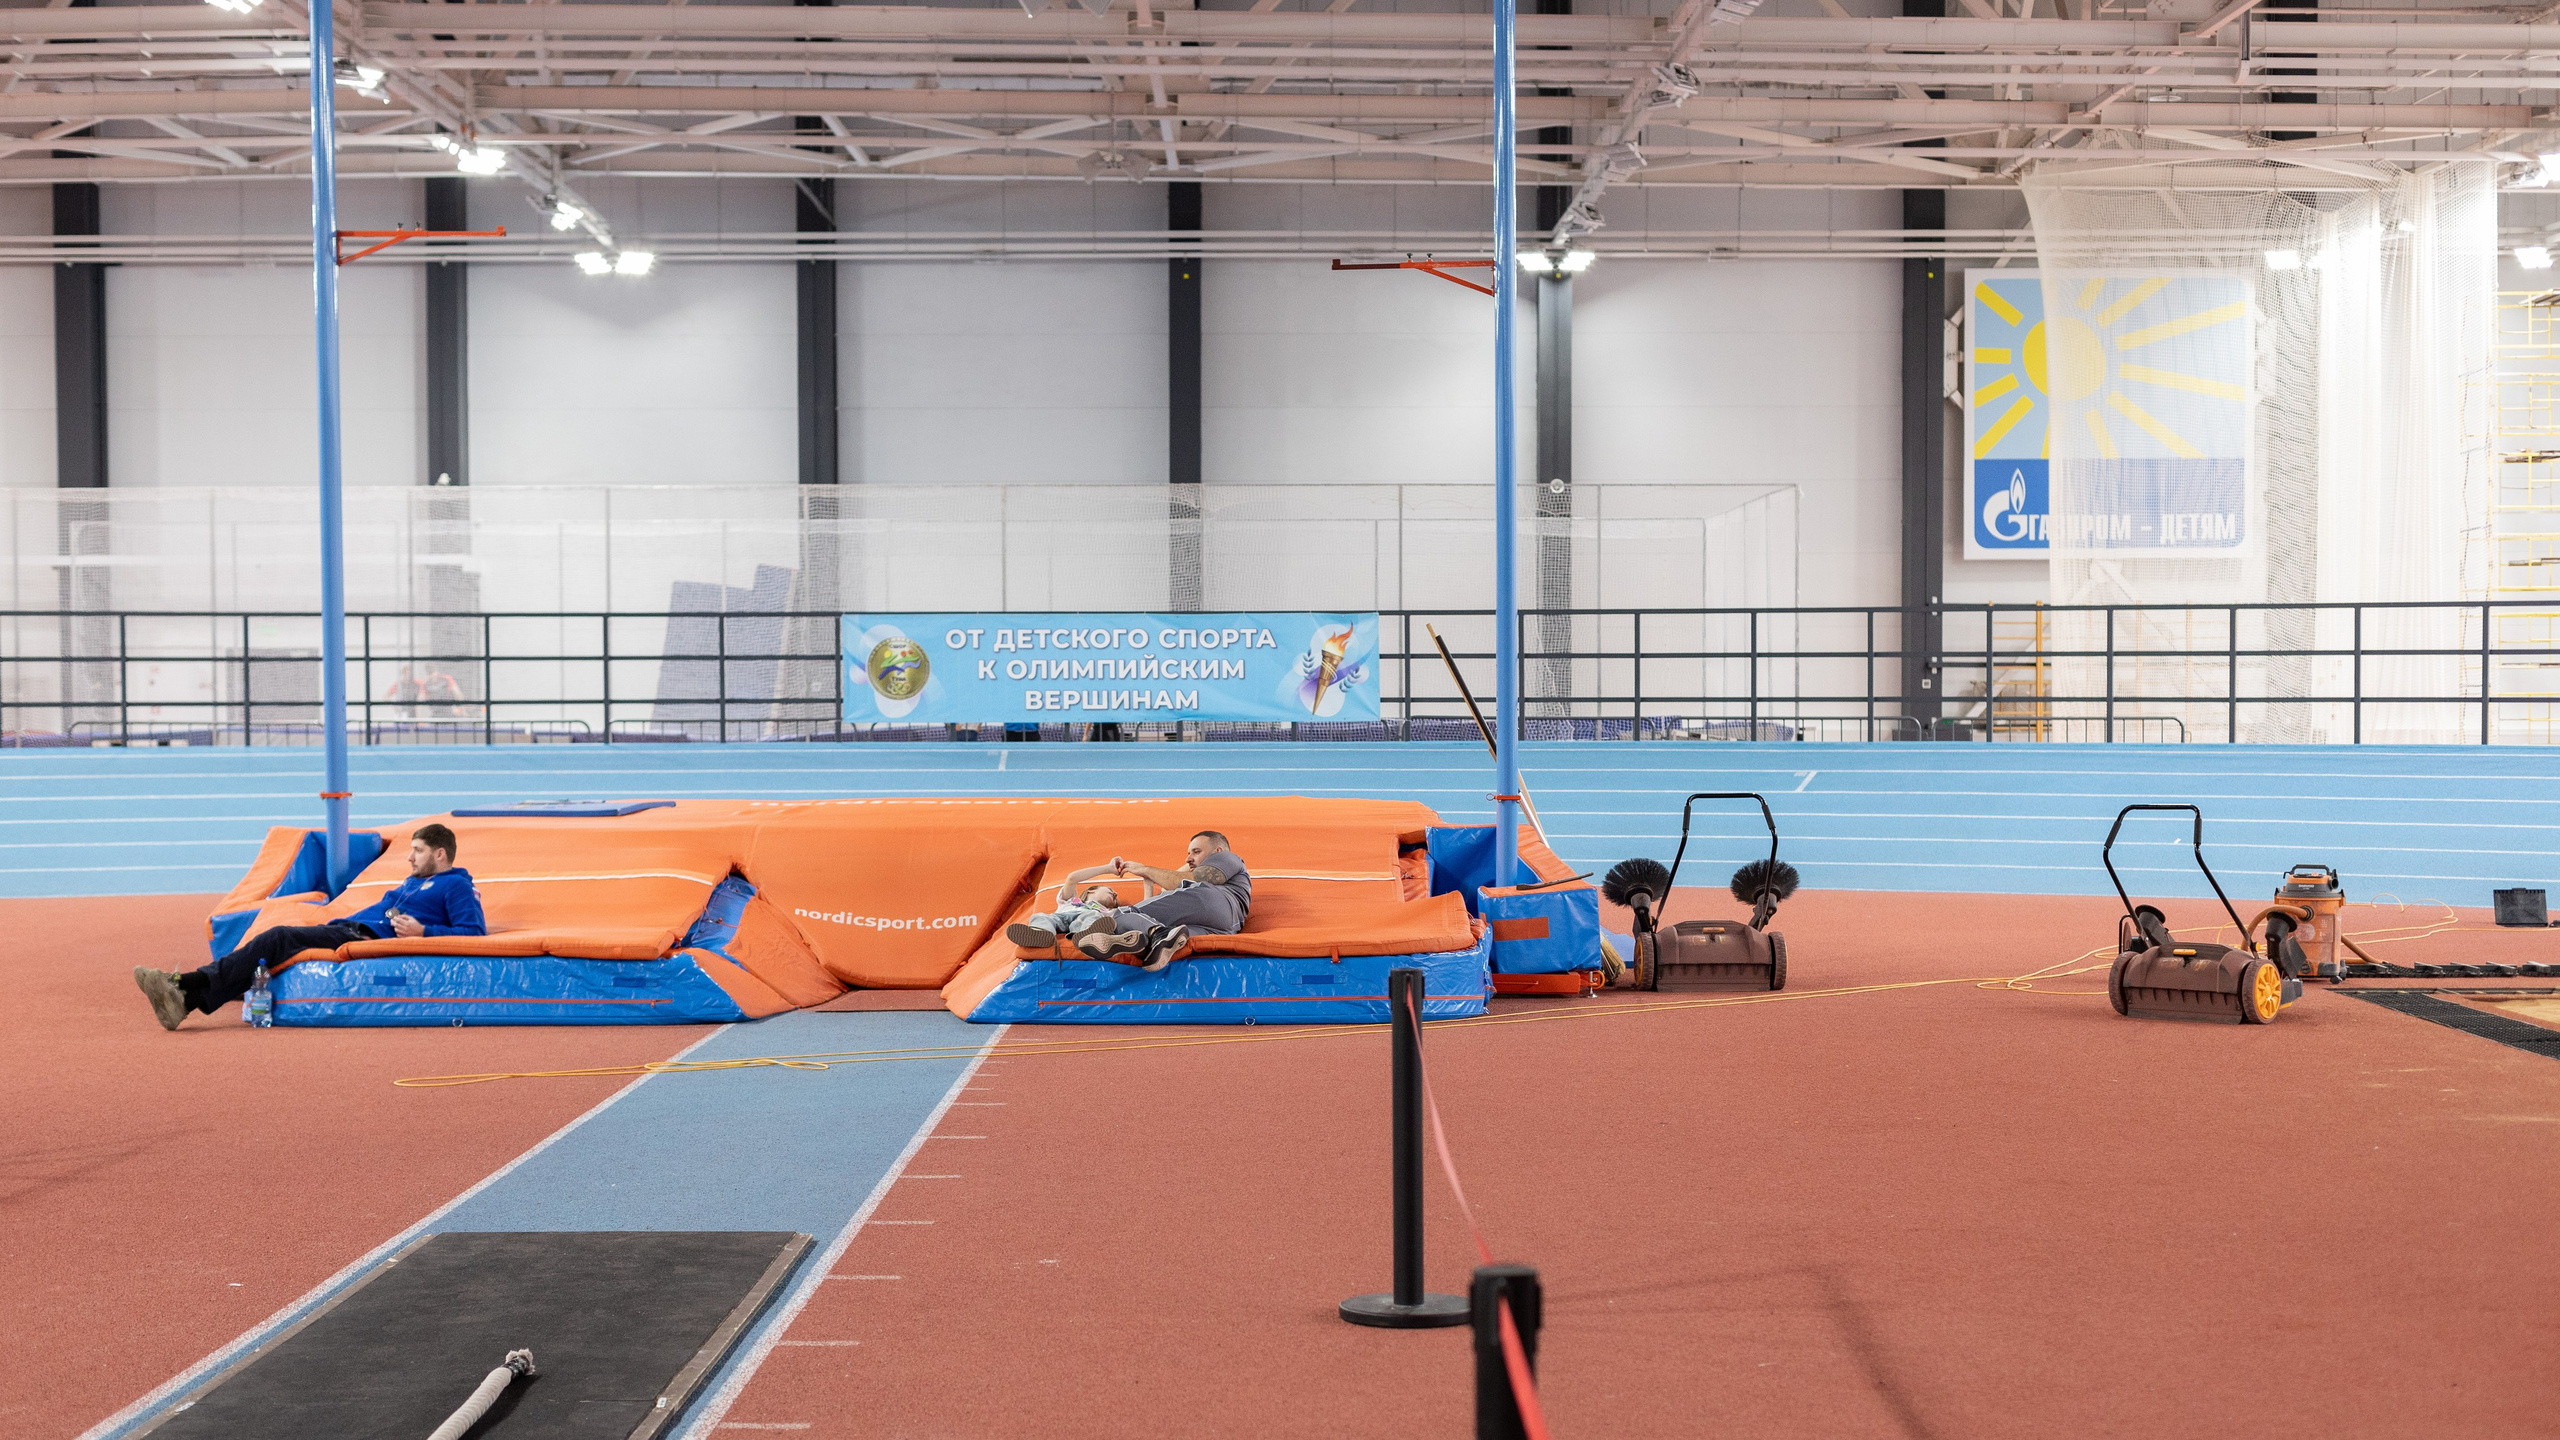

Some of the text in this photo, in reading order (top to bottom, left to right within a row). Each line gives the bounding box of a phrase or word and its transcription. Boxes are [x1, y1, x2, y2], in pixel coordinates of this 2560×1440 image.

[2159, 513, 2236, 545] ДЕТЯМ
[945, 628, 1277, 653] ОТ ДЕТСКОГО СПОРТА
[978, 653, 1245, 680] К ОЛИМПИЙСКИМ
[1025, 689, 1199, 710] ВЕРШИНАМ
[794, 907, 978, 932] nordicsport.com
